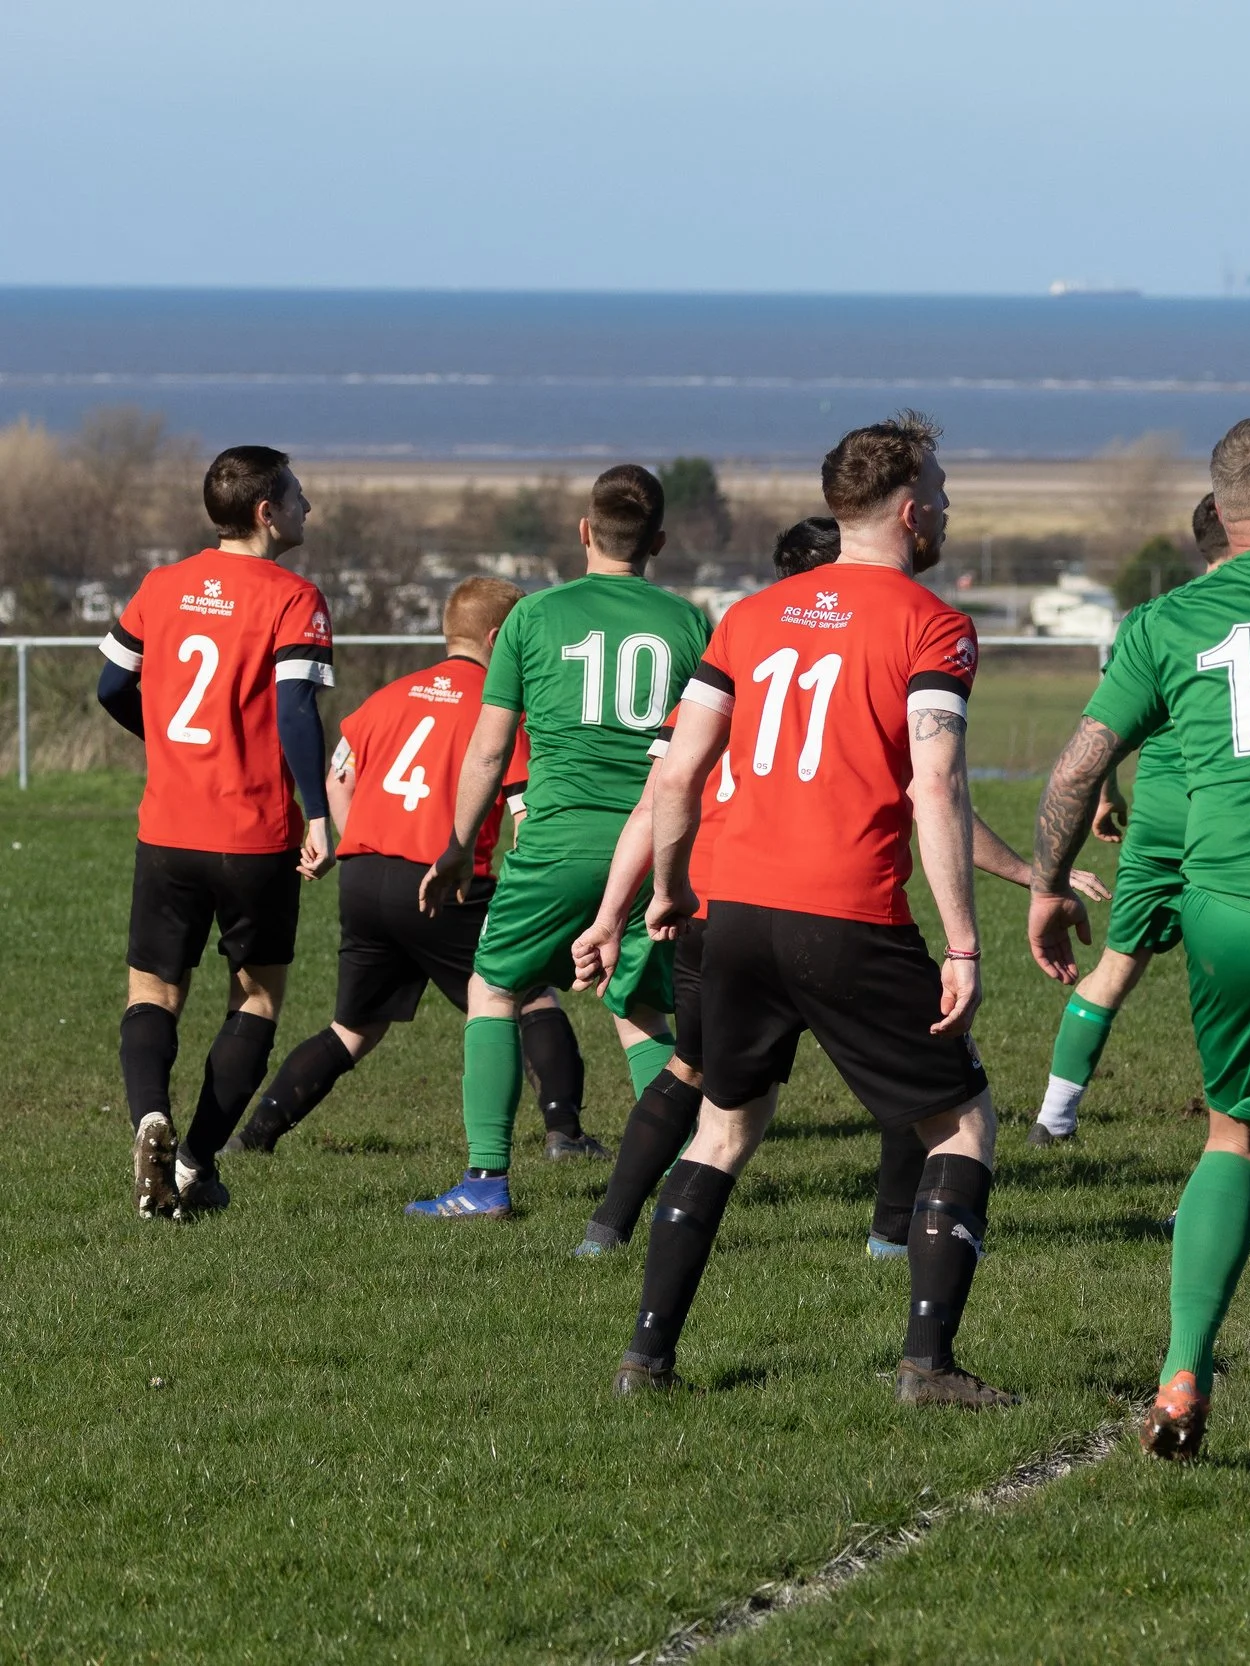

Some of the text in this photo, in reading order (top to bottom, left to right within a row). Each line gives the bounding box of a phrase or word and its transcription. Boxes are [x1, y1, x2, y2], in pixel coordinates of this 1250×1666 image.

[179, 603, 207, 615] cleaning
[181, 594, 235, 610] RG HOWELLS
[780, 614, 817, 629] cleaning
[784, 606, 853, 622] RG HOWELLS
[166, 634, 220, 745] 2
[561, 630, 673, 732] 10
[752, 647, 843, 782] 11
[382, 715, 436, 812] 4
